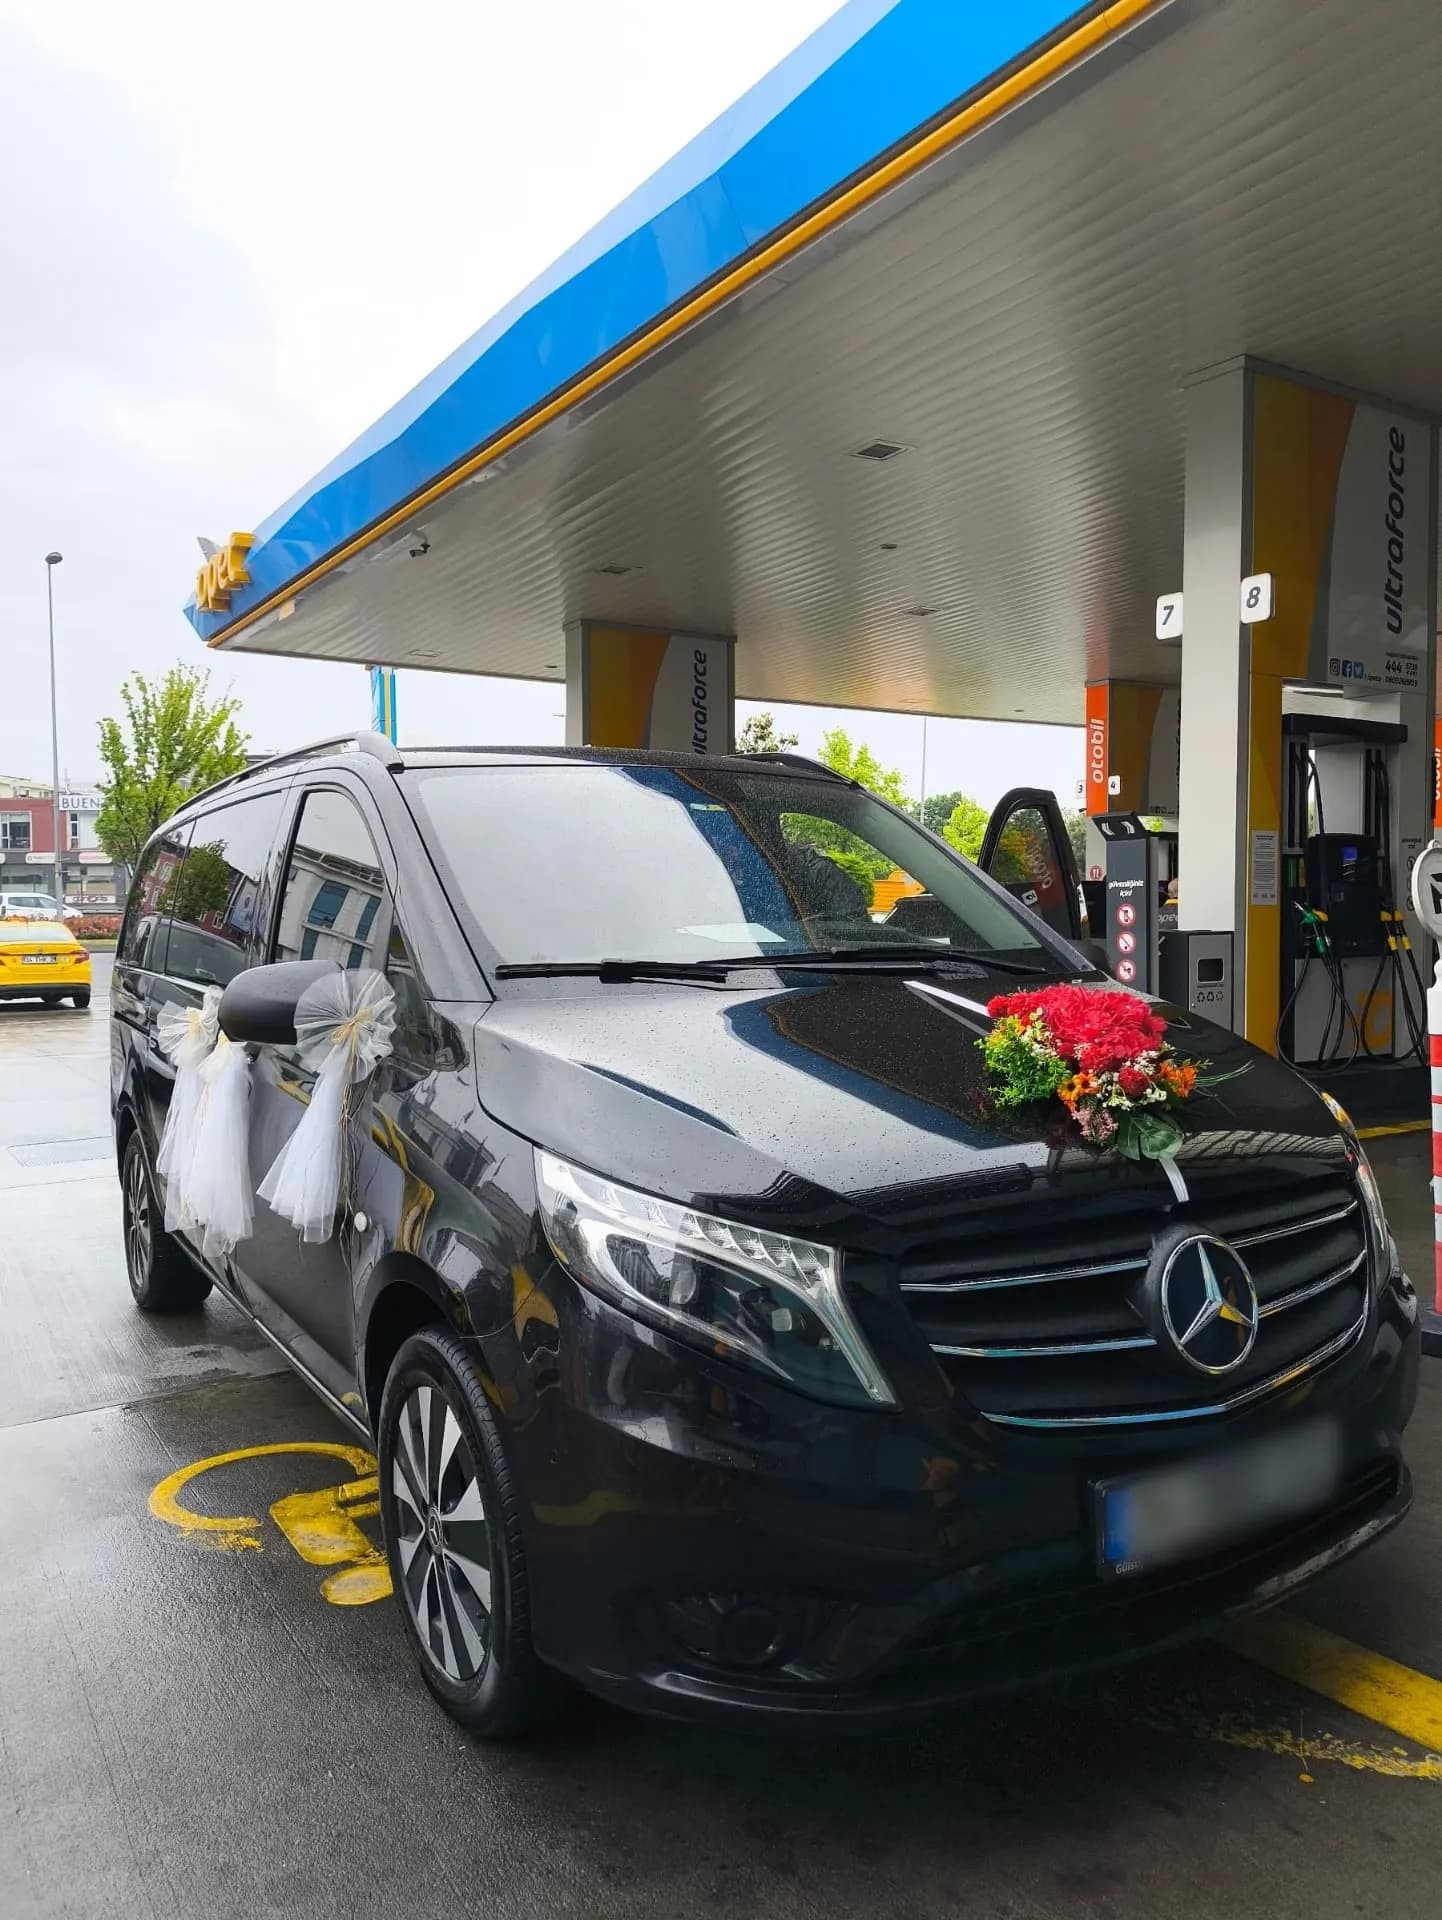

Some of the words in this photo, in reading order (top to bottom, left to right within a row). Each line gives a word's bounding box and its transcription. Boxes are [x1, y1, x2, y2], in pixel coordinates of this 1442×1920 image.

[1383, 425, 1405, 635] ultraforce
[1161, 604, 1175, 626] 7
[1246, 586, 1261, 609] 8
[1090, 718, 1105, 784] otobil
